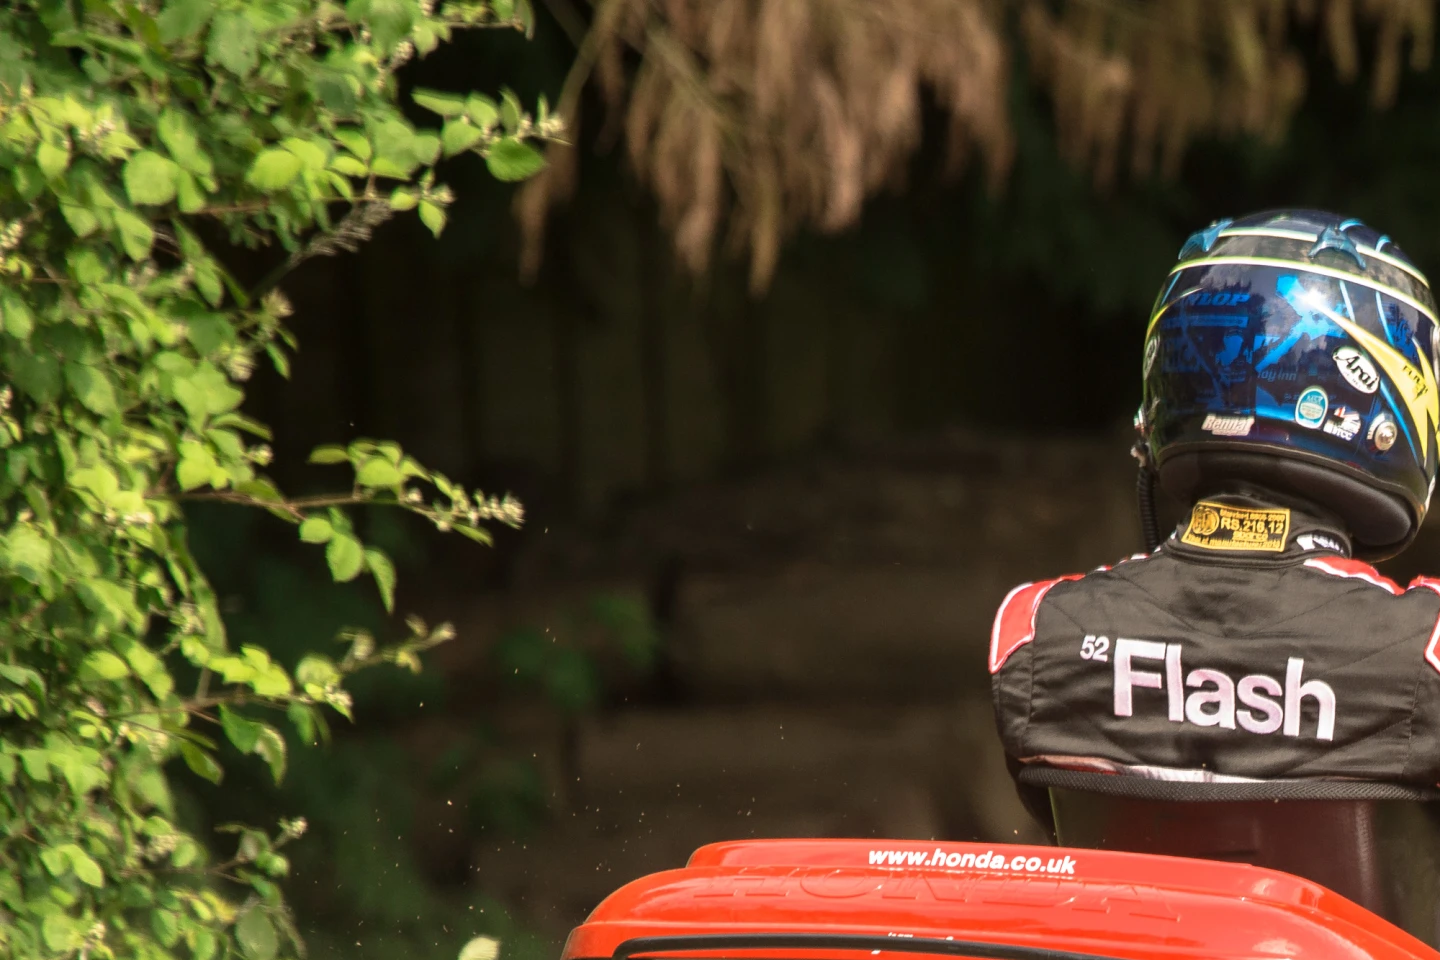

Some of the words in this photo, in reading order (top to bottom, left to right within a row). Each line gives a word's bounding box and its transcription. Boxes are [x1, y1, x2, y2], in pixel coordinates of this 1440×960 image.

[1332, 353, 1379, 391] Arai
[1080, 635, 1110, 662] 52
[1113, 637, 1337, 742] Flash
[868, 848, 1077, 875] www.honda.co.uk
